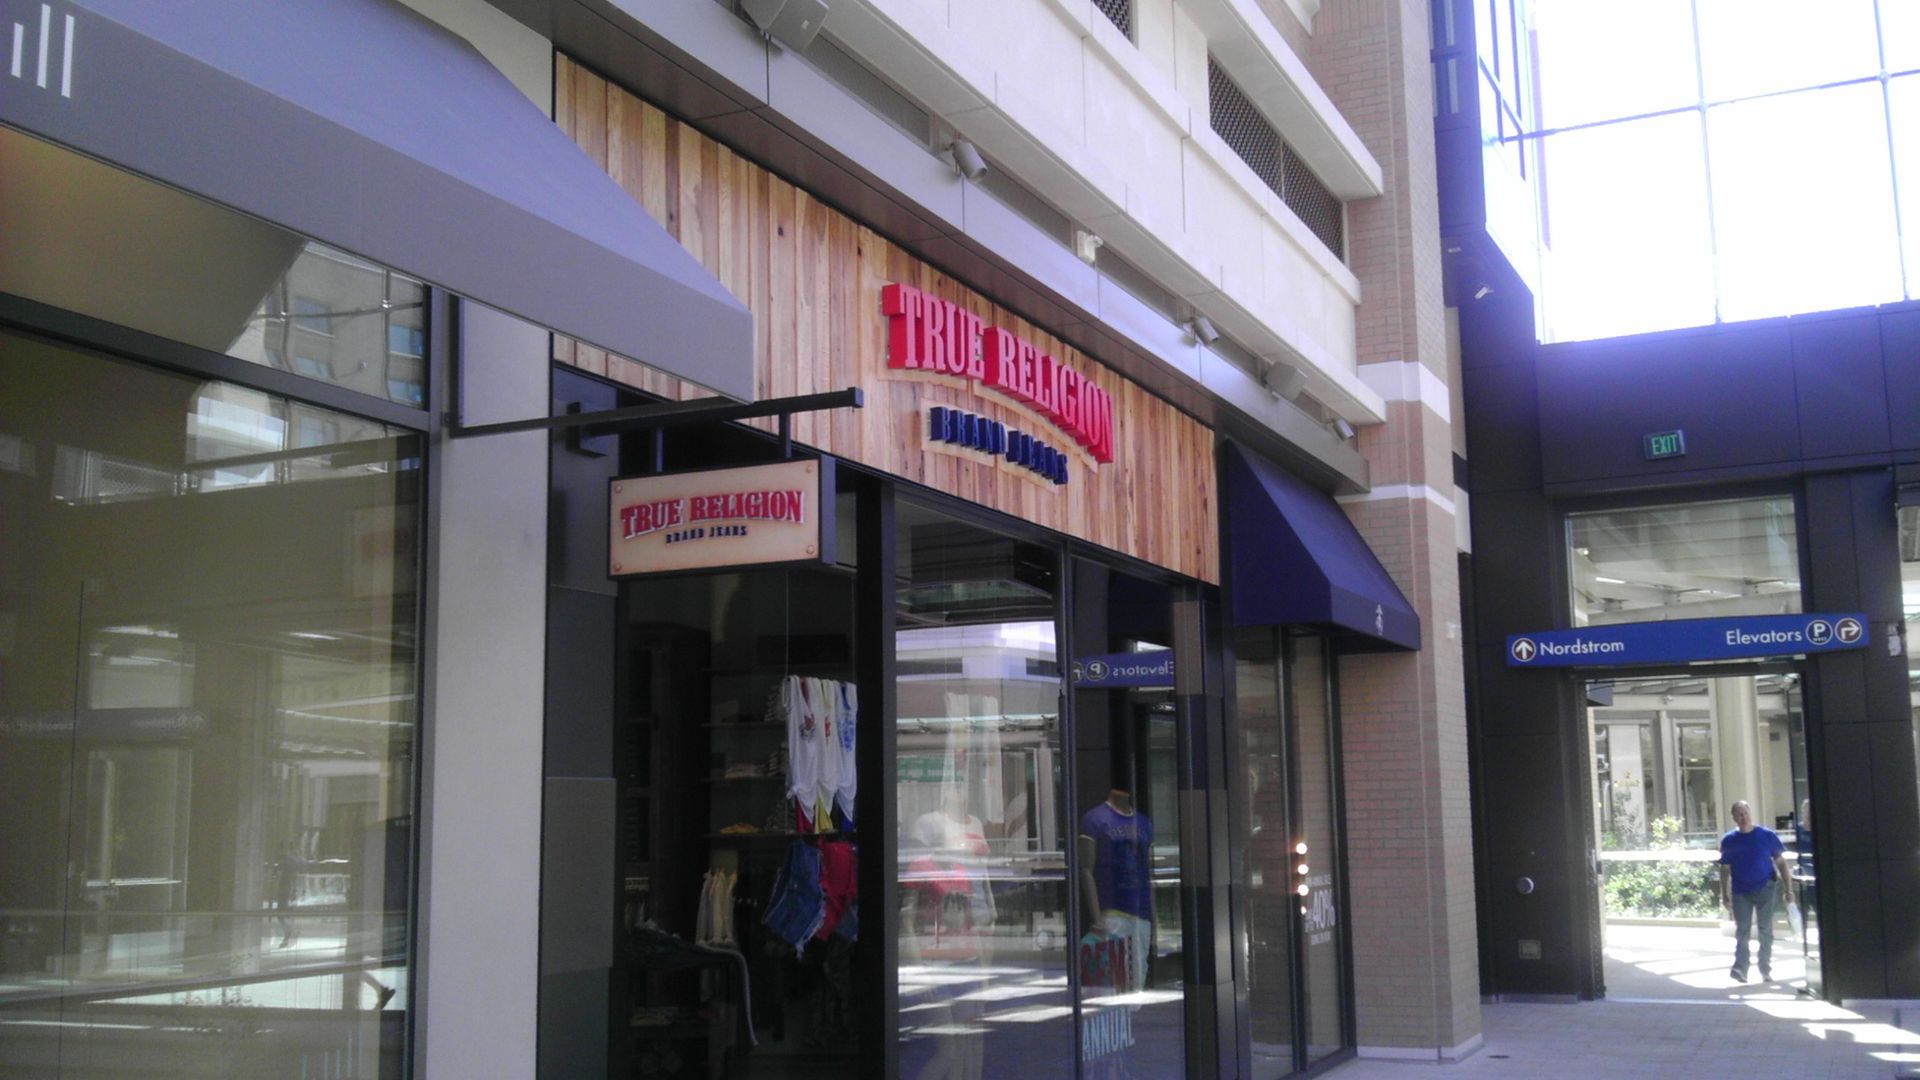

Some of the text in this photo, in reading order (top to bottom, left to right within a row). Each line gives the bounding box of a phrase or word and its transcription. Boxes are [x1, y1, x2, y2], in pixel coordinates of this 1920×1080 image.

[882, 283, 1114, 464] TRUE RELIGION
[930, 406, 1069, 485] BRAND JEANS
[1651, 434, 1678, 455] EXIT
[620, 490, 805, 540] TRUE RELIGION
[666, 525, 747, 544] BRAND JEANS
[1540, 638, 1625, 656] Nordstrom
[1726, 628, 1803, 645] Elevators
[1082, 1007, 1136, 1062] ANNUAL
